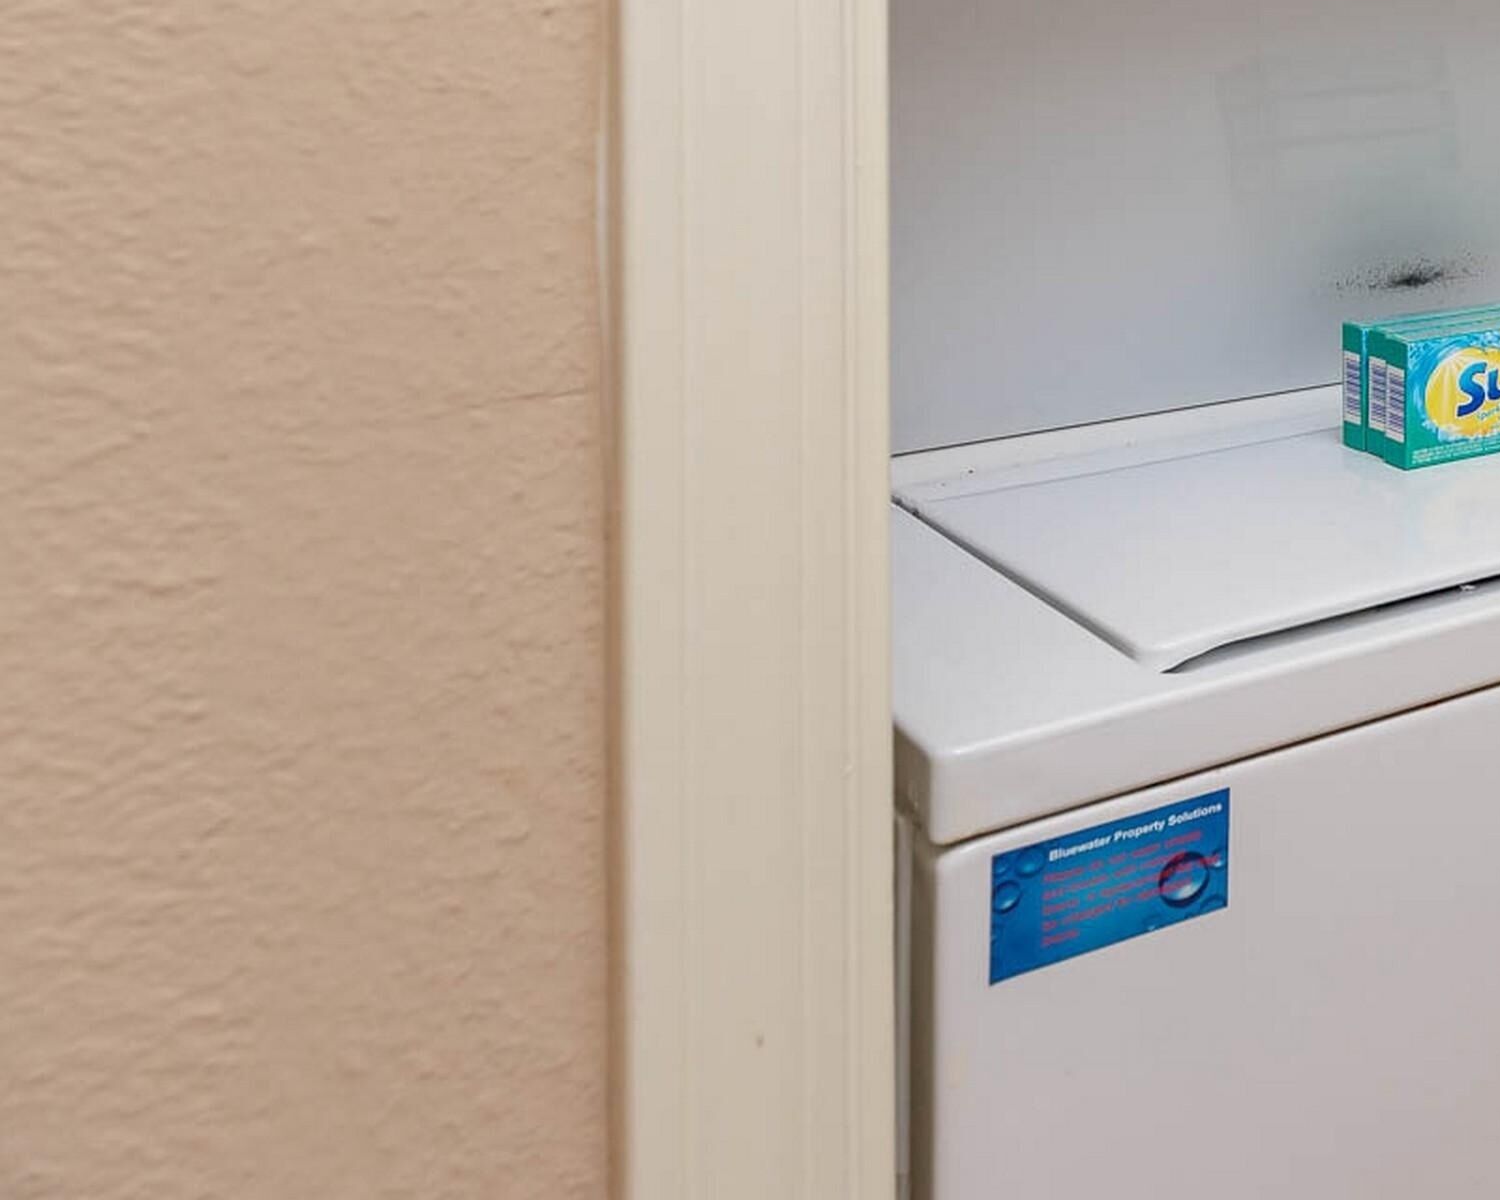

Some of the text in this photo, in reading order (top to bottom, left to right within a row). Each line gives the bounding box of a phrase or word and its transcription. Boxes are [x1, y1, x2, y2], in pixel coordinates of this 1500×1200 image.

[1049, 802, 1223, 862] Bluewater Property Solutions
